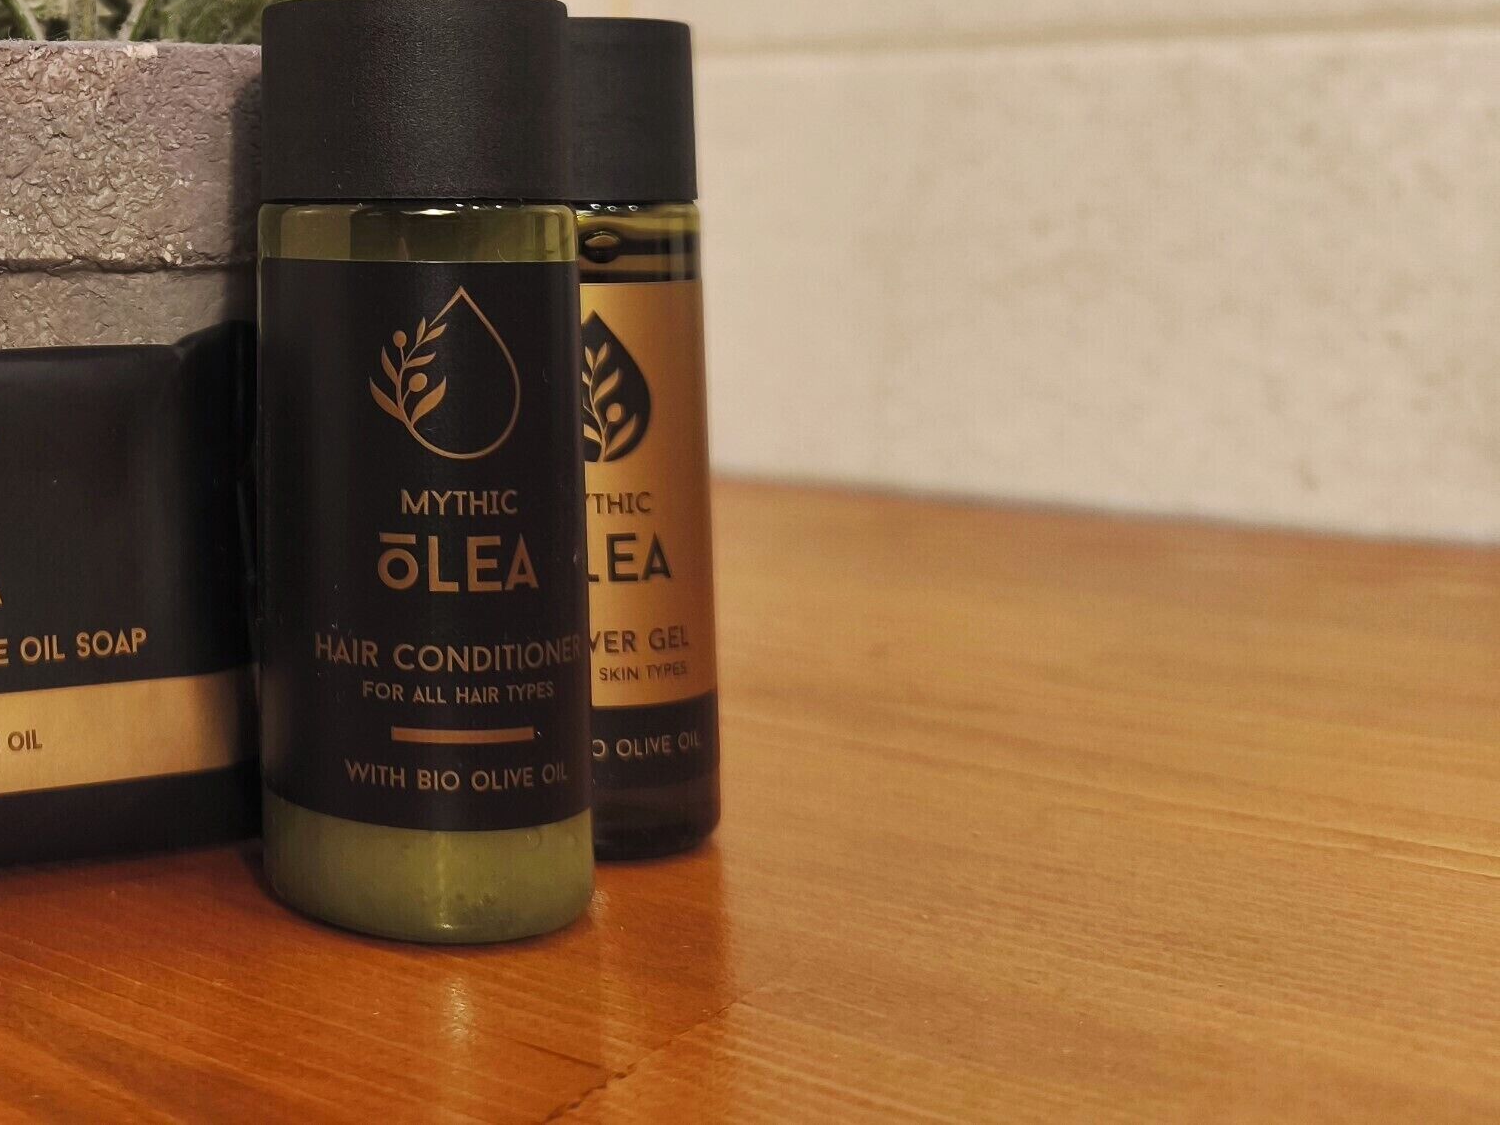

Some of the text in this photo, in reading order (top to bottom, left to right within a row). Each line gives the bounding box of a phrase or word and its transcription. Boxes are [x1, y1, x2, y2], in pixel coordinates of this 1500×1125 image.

[401, 489, 518, 516] MYTHIC
[20, 634, 65, 662] OIL
[76, 627, 147, 657] SOAP
[648, 626, 689, 651] GEL
[315, 633, 581, 672] HAIR CONDITIONER
[599, 662, 687, 682] SKIN TYPES
[362, 681, 554, 704] FOR ALL HAIR TYPES
[7, 729, 43, 751] OIL
[616, 736, 672, 758] OLIVE
[679, 732, 701, 750] OIL
[345, 759, 568, 791] WITH BIO OLIVE OIL
